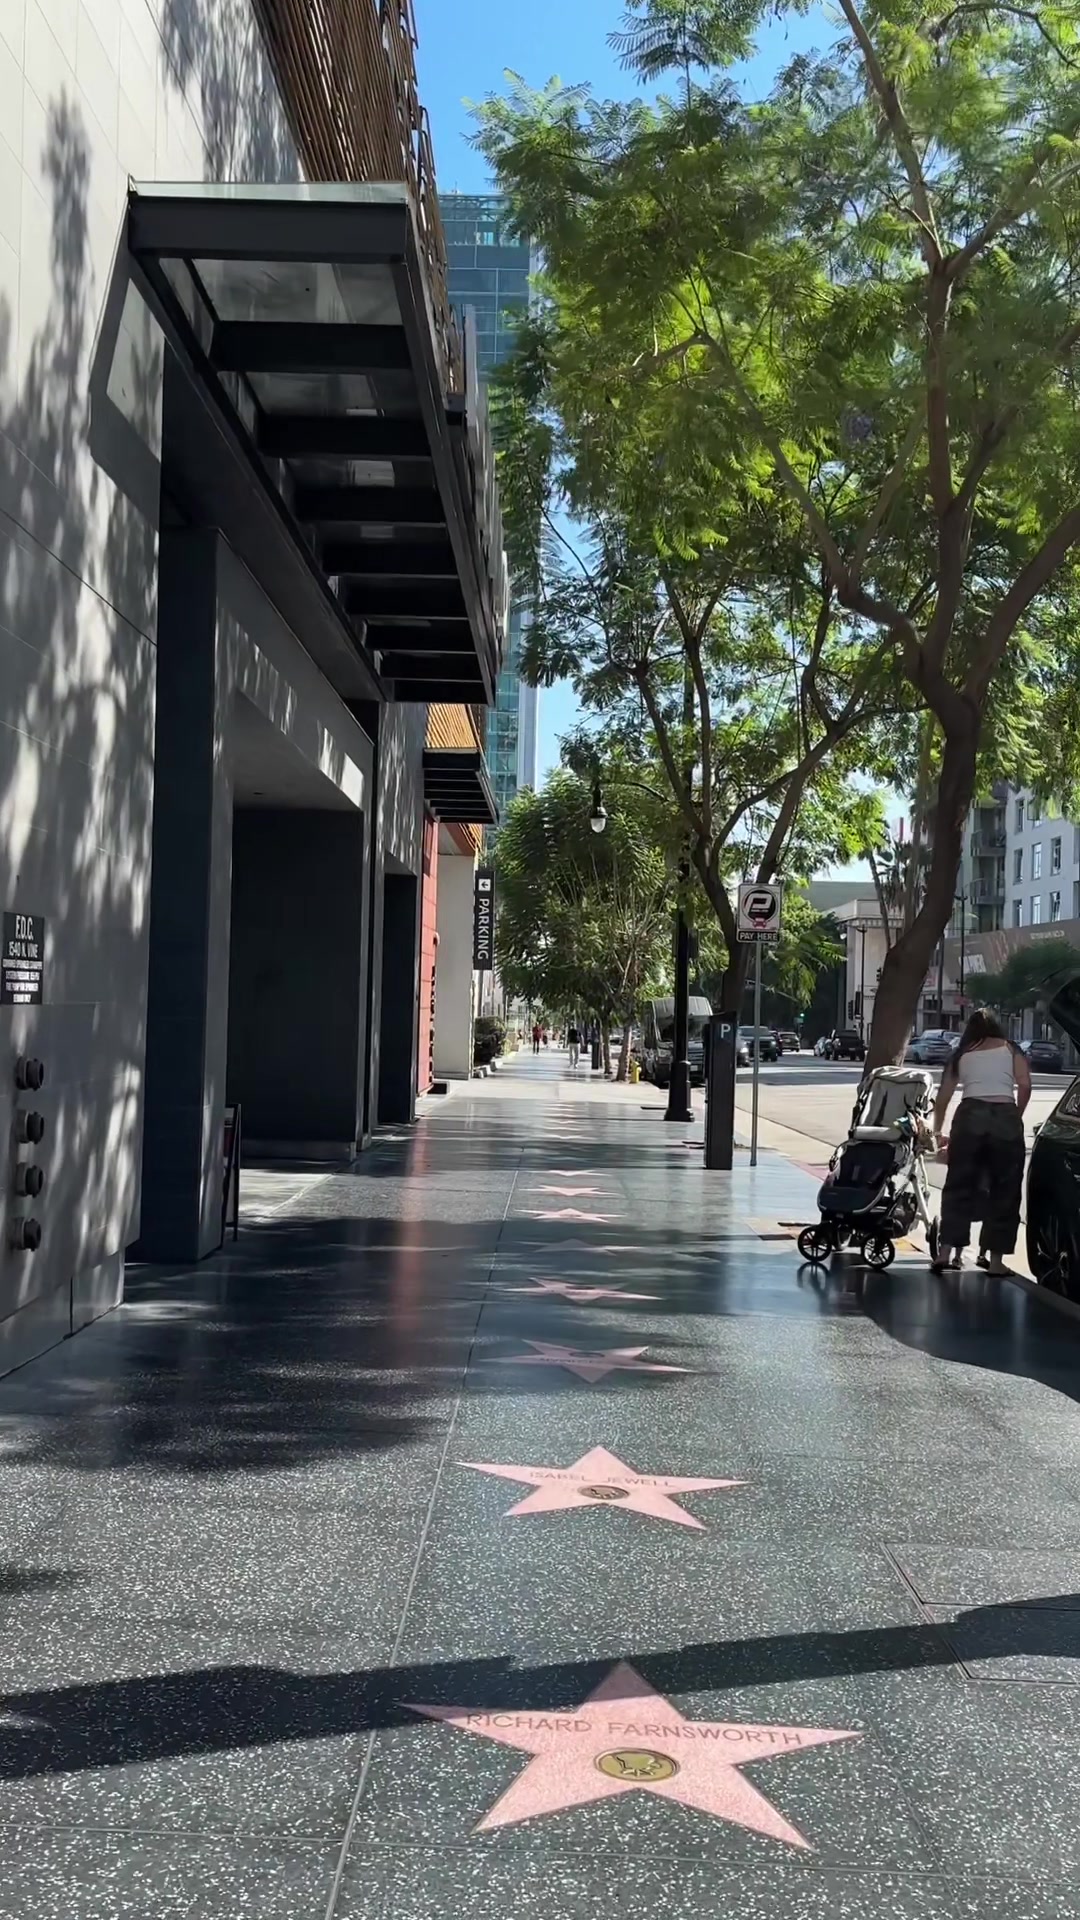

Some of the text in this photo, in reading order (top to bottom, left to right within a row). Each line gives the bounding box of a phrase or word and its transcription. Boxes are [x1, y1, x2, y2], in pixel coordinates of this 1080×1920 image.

[478, 898, 490, 960] PARKING
[739, 932, 778, 941] PAY HERE
[27, 943, 38, 958] VINE
[720, 1023, 732, 1039] P
[529, 1471, 676, 1488] ISABEL JEWELL
[466, 1712, 803, 1746] RICHARD FARNSWORTH
